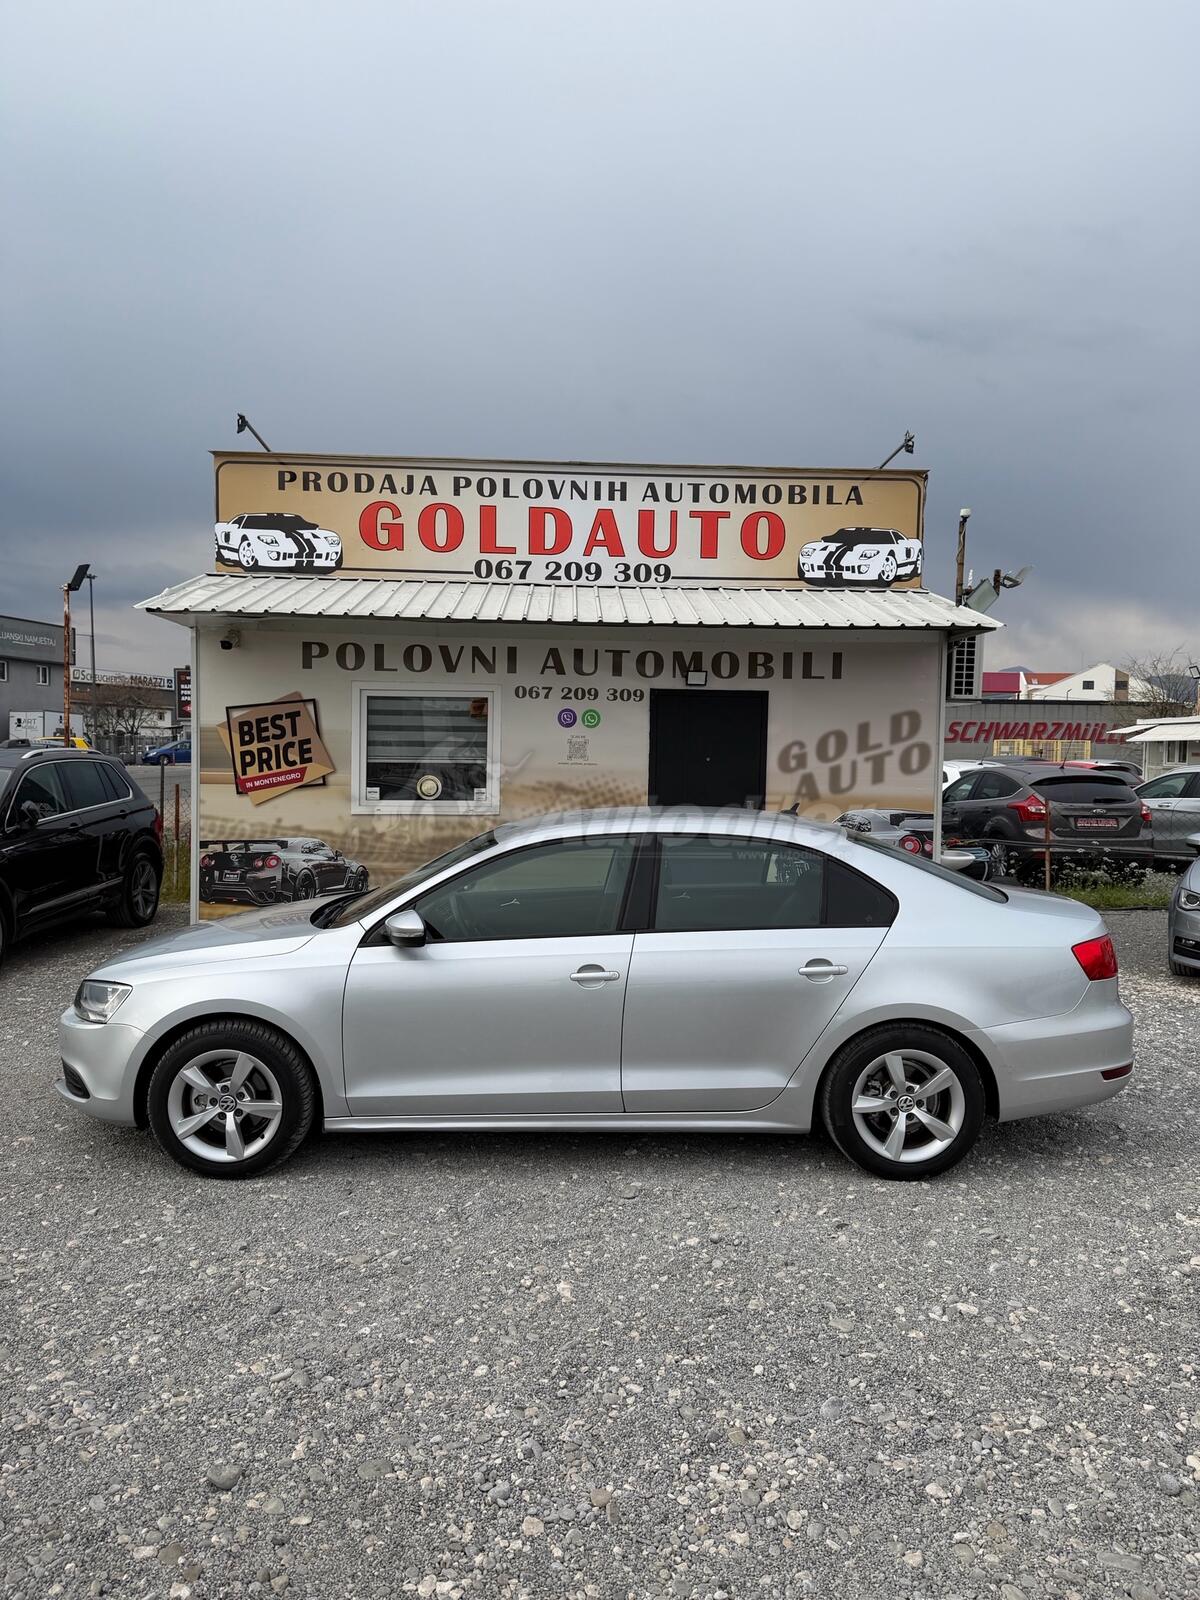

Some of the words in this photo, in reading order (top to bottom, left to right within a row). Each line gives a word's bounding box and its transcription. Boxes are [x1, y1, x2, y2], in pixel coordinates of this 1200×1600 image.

[277, 470, 439, 496] PRODAJA
[452, 476, 628, 501] POLOVNIH
[641, 481, 864, 506] AUTOMOBILA
[358, 500, 787, 561] GOLDAUTO
[473, 558, 533, 581] 067
[545, 561, 602, 583] 209
[613, 562, 672, 584] 309
[301, 641, 519, 675] POLOVNI
[539, 646, 845, 681] AUTOMOBILI
[514, 685, 553, 700] 067
[560, 686, 599, 701] 209
[606, 687, 645, 702] 309
[238, 710, 302, 747] BEST
[777, 709, 922, 774] GOLD
[239, 737, 313, 776] PRICE
[794, 740, 932, 801] AUTO
[245, 781, 254, 789] IN
[254, 772, 302, 787] MONTENEGRO
